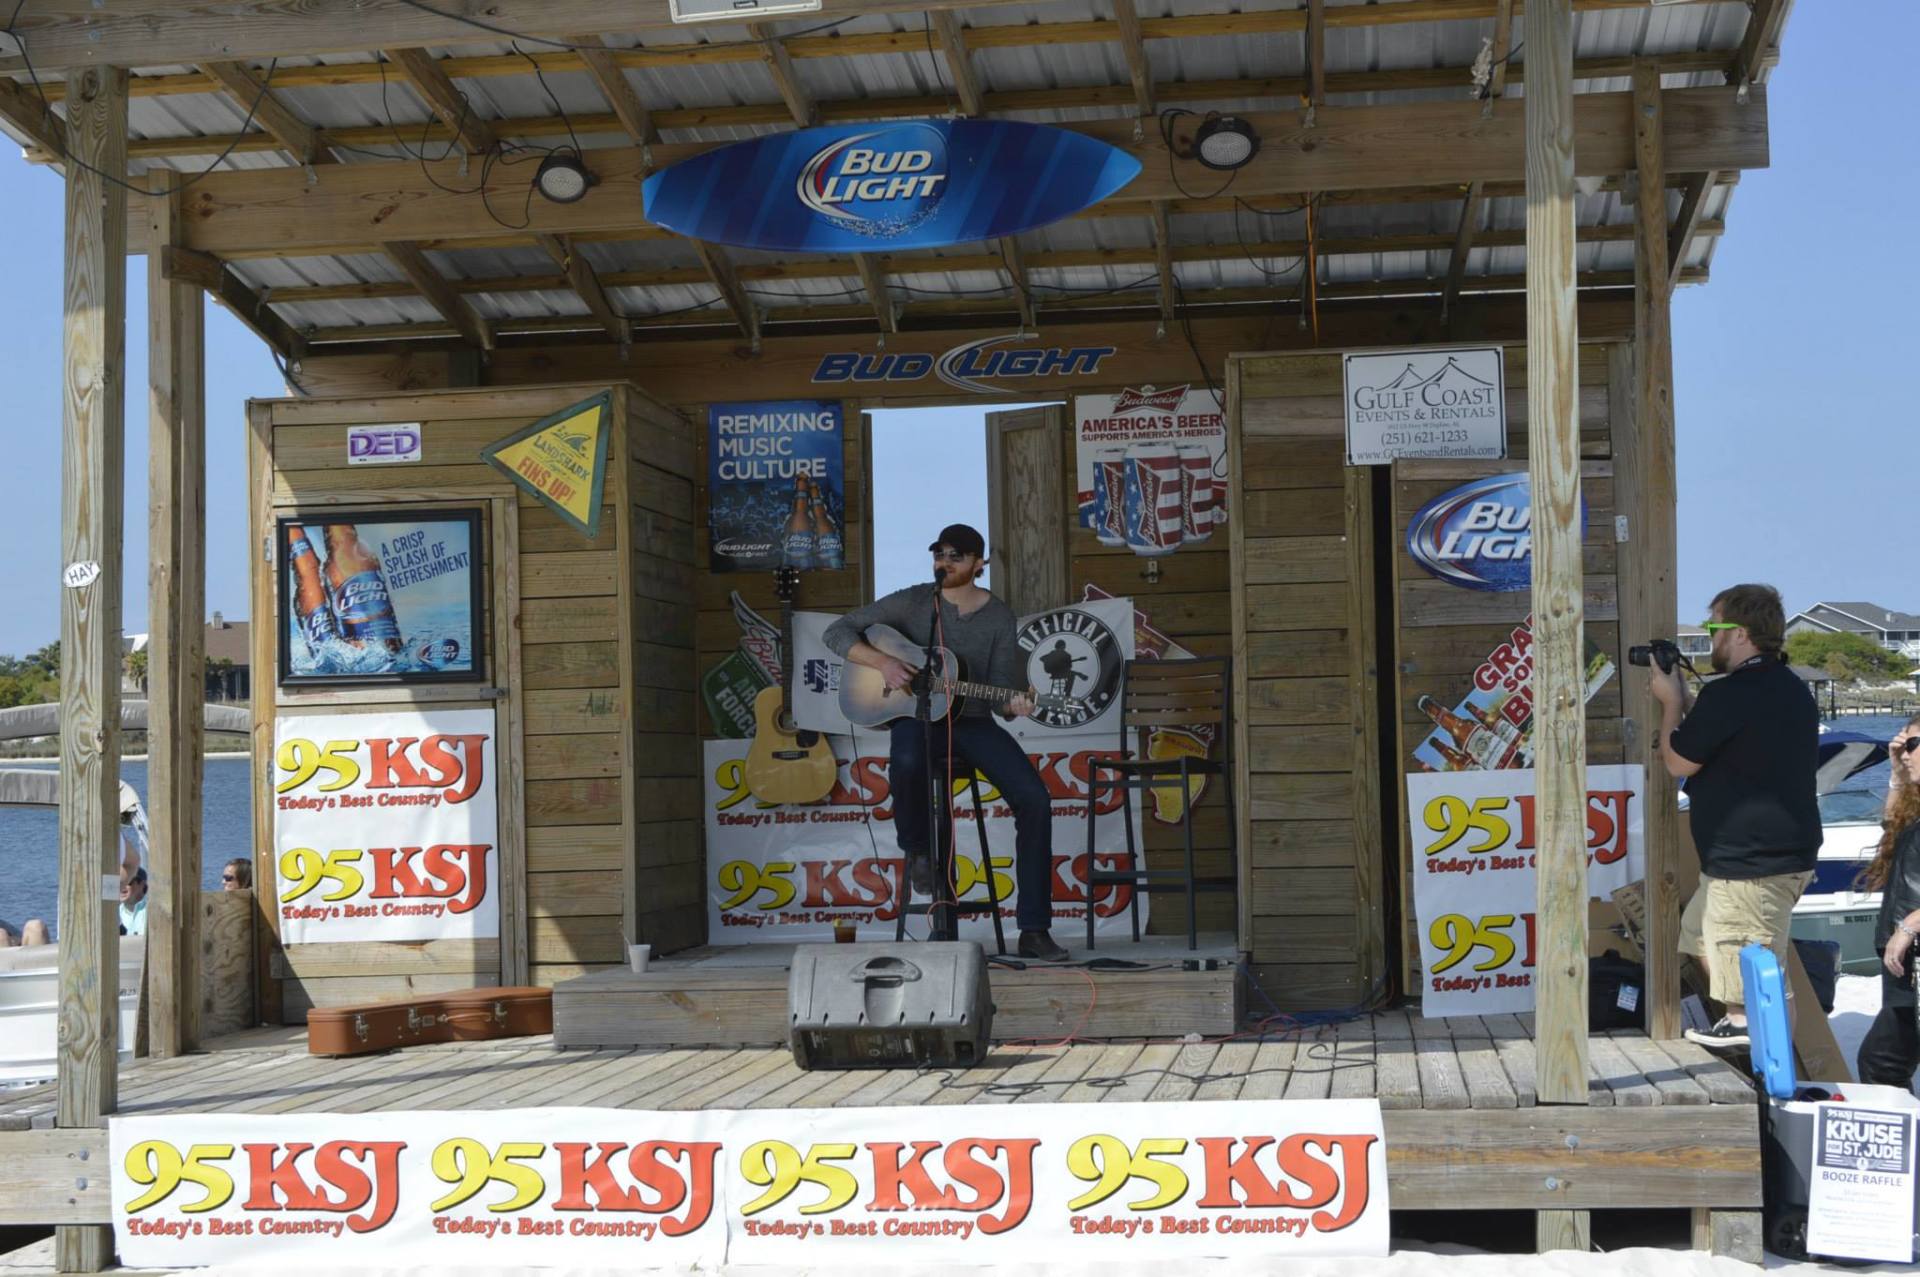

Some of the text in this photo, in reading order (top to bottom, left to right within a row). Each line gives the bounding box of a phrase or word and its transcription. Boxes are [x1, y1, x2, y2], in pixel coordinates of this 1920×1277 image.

[840, 149, 932, 175] BUD
[822, 175, 946, 204] LIGHT
[811, 347, 1117, 383] BUD LIGHT
[1354, 383, 1494, 410] GULF COAST
[718, 412, 834, 434] REMIXING
[1082, 414, 1221, 432] AMERICA'S BEER
[1355, 407, 1495, 423] EVENTS & RENTALS
[350, 431, 420, 457] DED
[718, 436, 793, 457] MUSIC
[1081, 428, 1222, 442] SUPPORTS AMERICA'S HEROES
[1381, 430, 1468, 446] (251) 621-1233
[532, 434, 591, 481] LANDSHARK
[718, 458, 826, 480] CULTURE
[516, 455, 549, 489] FINS
[548, 482, 577, 506] UP!
[1463, 502, 1531, 532] BU
[381, 530, 425, 558] A CRISP
[385, 541, 446, 575] SPLASH OF
[68, 562, 93, 584] HAY
[389, 551, 470, 591] REFRESHMENT
[341, 591, 388, 611] LIGHT
[346, 581, 384, 596] BUD
[1018, 612, 1108, 651] OFFICIAL
[276, 734, 489, 803] 95 KSJ
[277, 793, 442, 811] Today's Best Country
[717, 810, 871, 828] Today's Best Country
[1423, 795, 1511, 856] 95
[1426, 856, 1486, 875] Today's
[1490, 856, 1525, 870] Best
[279, 844, 493, 914] 95 KSJ
[719, 860, 797, 912] 95
[282, 903, 445, 921] Today's Best Country
[721, 912, 775, 928] Today's
[779, 911, 811, 924] Best
[814, 910, 873, 924] Country
[1429, 914, 1516, 975] 95
[1432, 973, 1531, 993] Today's Best
[1826, 1119, 1903, 1145] KRUISE
[1843, 1141, 1863, 1156] ST.
[1864, 1143, 1903, 1159] JUDE
[124, 1140, 408, 1234] 95 KSJ
[430, 1137, 723, 1237] 95 KSJ
[740, 1138, 1042, 1235] 95 KSJ
[1066, 1133, 1378, 1232] 95 KSJ
[1822, 1171, 1904, 1187] BOOZE RAFFLE
[127, 1216, 345, 1239] Today's Best Country
[432, 1216, 658, 1241] Today's Best Country
[744, 1218, 974, 1240] Today's Best Country
[1069, 1215, 1310, 1239] Today's Best Country
